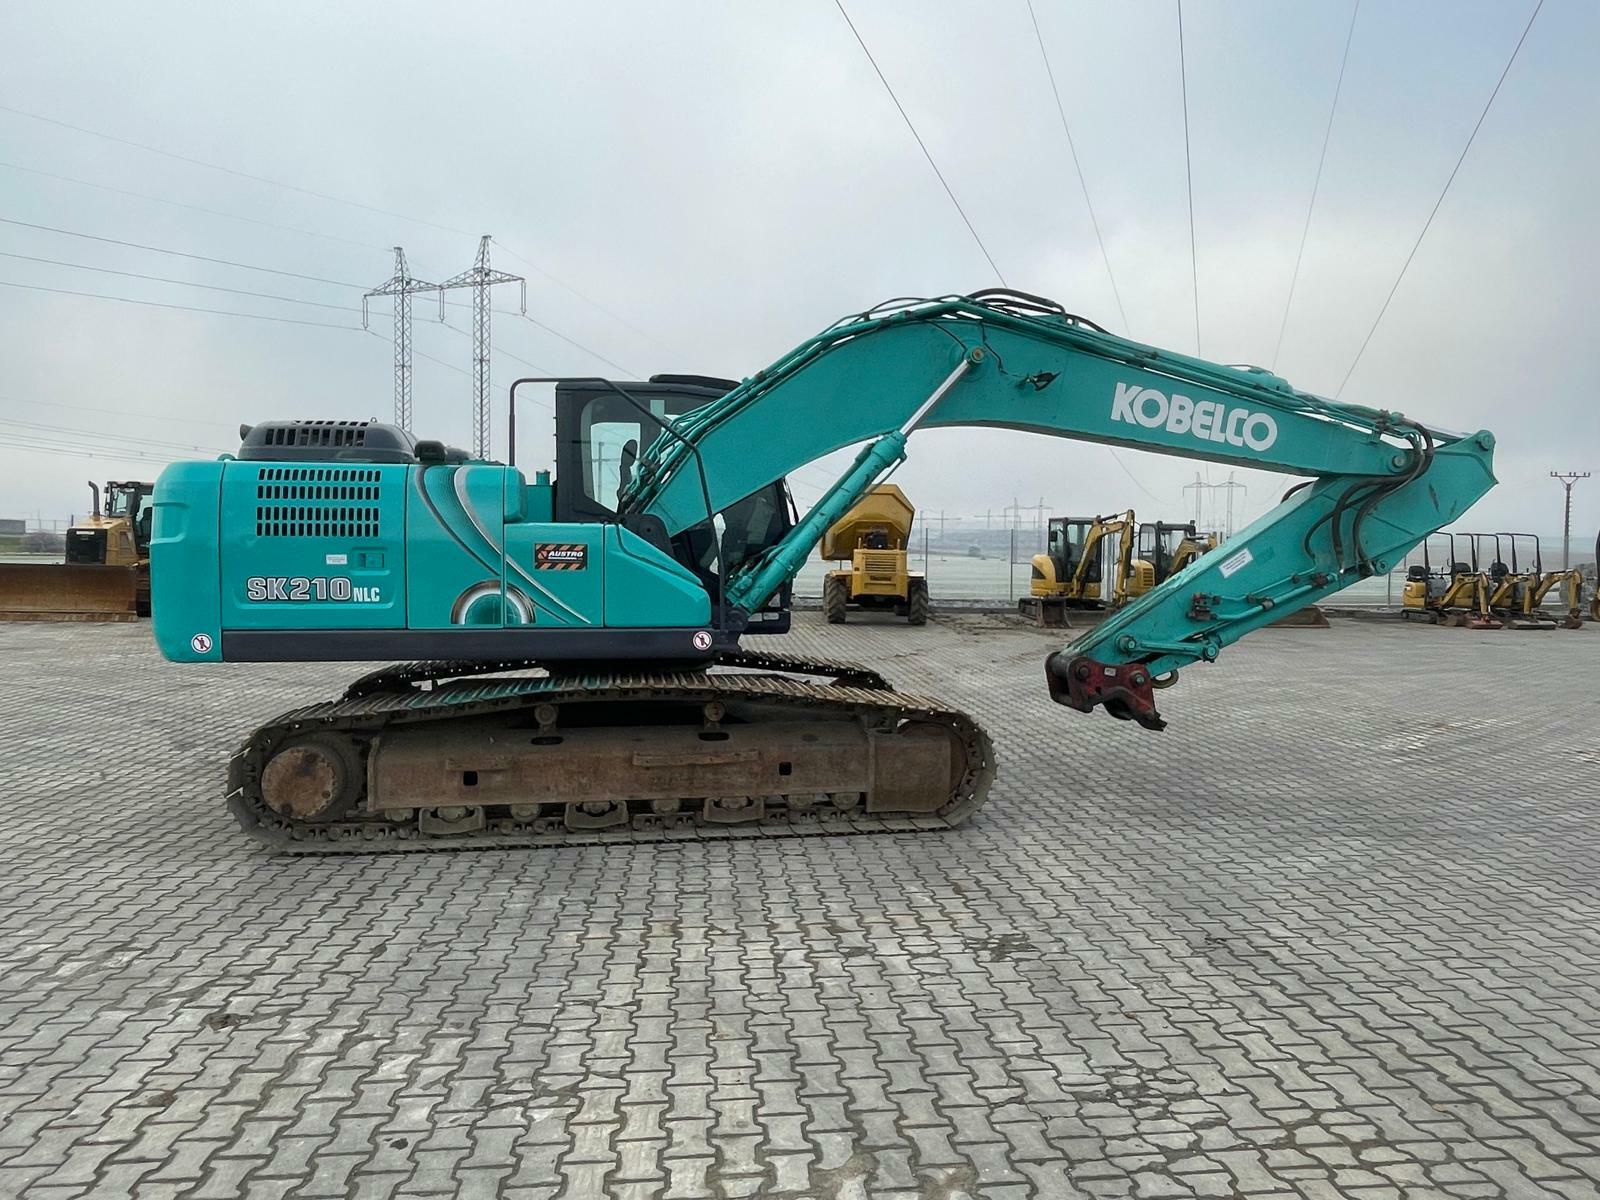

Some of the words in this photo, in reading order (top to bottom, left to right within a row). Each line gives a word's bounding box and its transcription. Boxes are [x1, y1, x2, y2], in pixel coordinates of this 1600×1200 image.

[1111, 382, 1278, 452] KOBELCO
[247, 577, 352, 601] SK210
[353, 587, 380, 602] NLC
